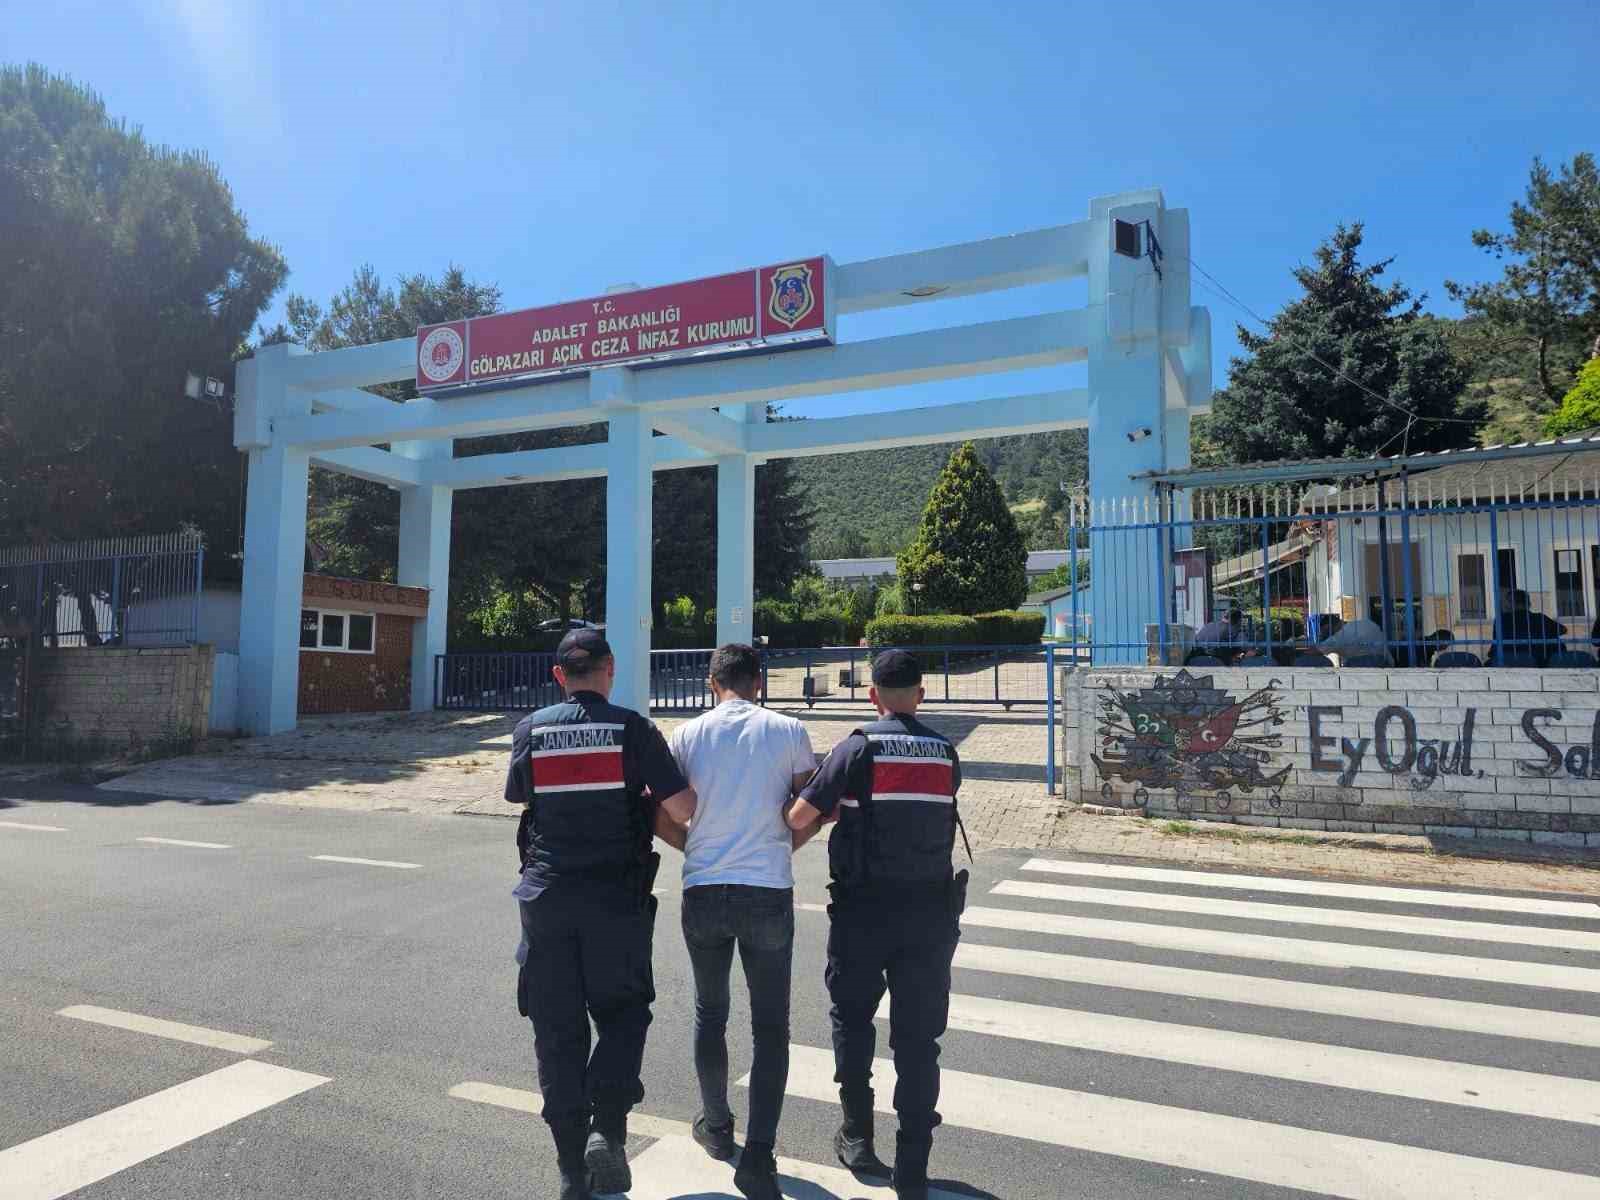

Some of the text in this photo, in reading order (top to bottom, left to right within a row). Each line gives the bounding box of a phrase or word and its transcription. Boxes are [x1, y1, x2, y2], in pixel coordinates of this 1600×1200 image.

[592, 300, 616, 315] T.C.
[532, 305, 681, 344] ADALET BAKANLIĞI
[470, 316, 755, 376] GÖLPAZARI AÇIK CEZA İNFAZ KURUMU
[540, 728, 615, 751] JANDARMA
[880, 740, 947, 759] JANDARMA
